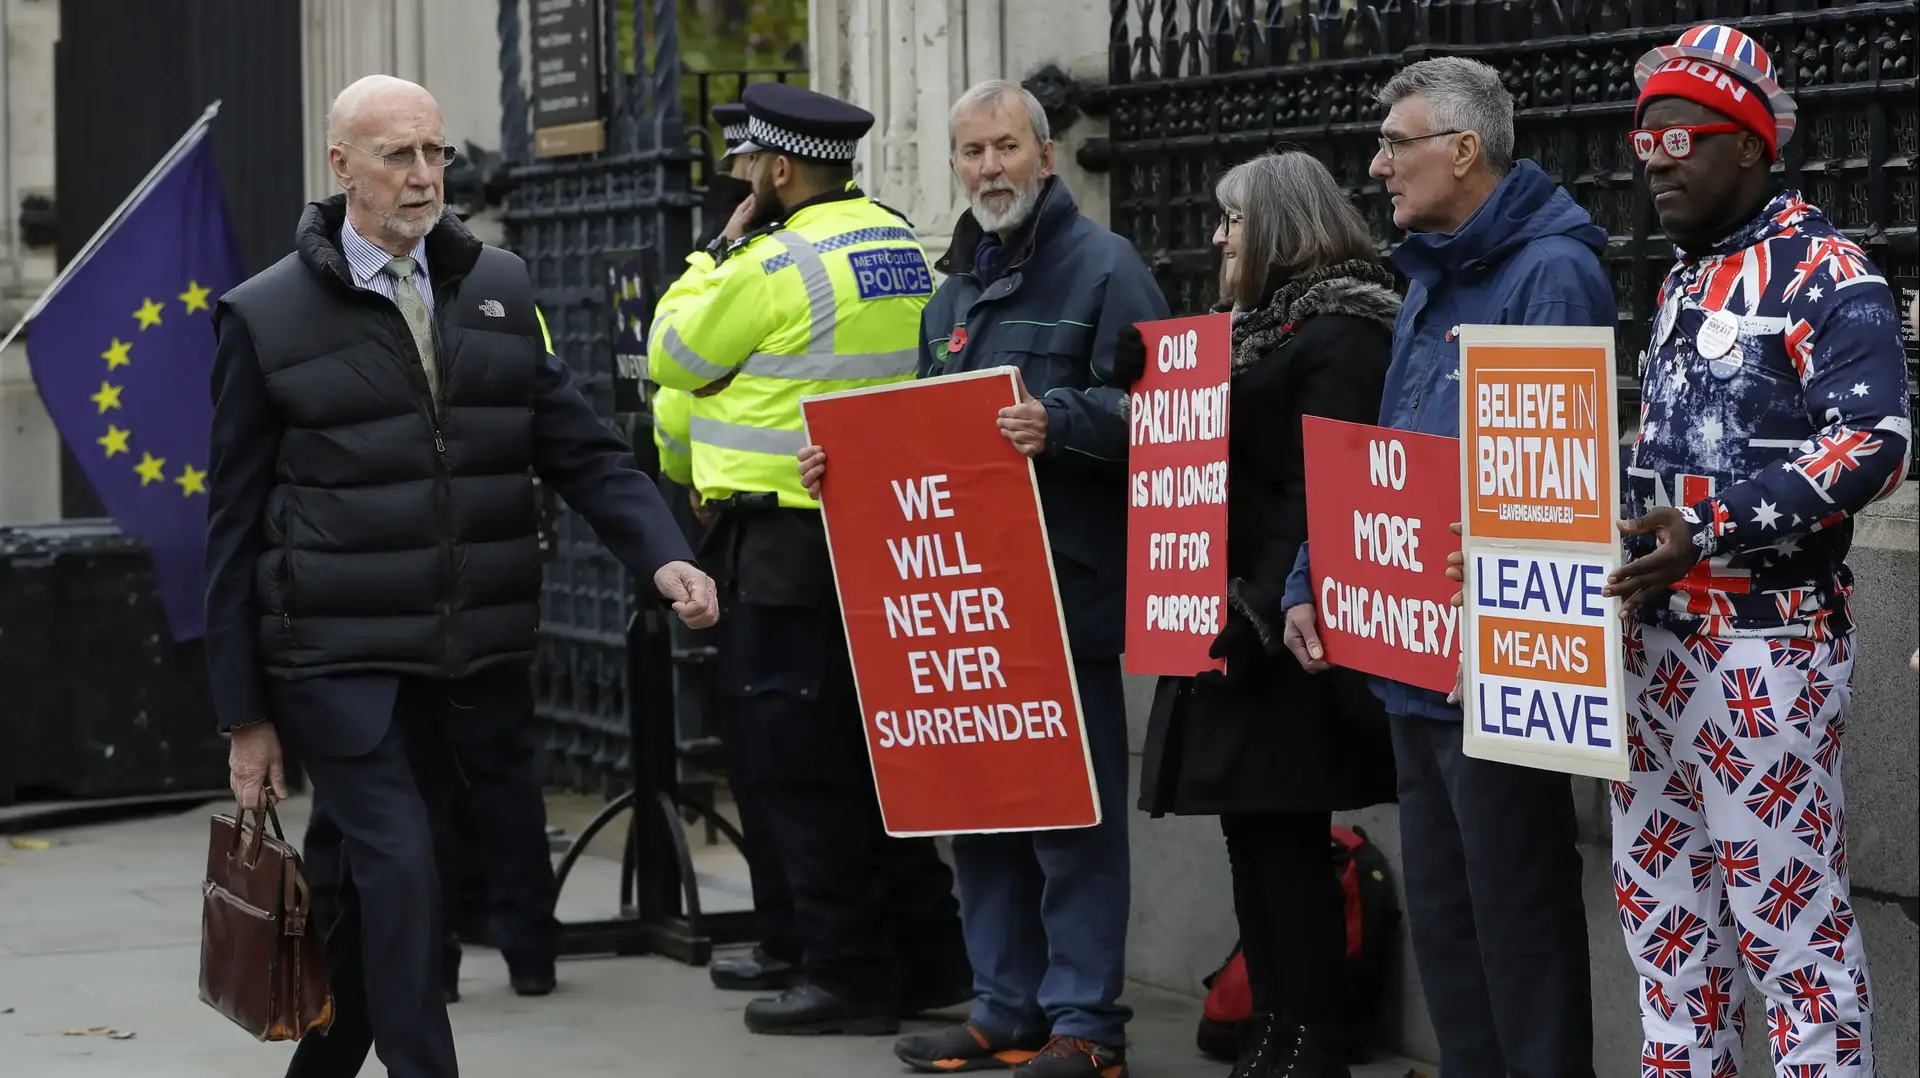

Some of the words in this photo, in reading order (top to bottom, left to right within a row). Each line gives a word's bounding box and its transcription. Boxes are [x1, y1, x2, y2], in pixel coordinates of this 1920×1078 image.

[1654, 59, 1747, 103] DON
[853, 252, 923, 267] METROOLITAN
[859, 266, 931, 293] POLICE
[1158, 329, 1198, 373] OUR
[1131, 382, 1229, 446] PARLIAMENT
[1478, 384, 1567, 430] BELIEVE
[1572, 384, 1594, 430] IN
[1132, 470, 1149, 508] IS
[1151, 466, 1174, 508] NO
[1176, 460, 1228, 508] LONGER
[1369, 439, 1407, 491] NO
[1478, 435, 1596, 500] BRITAIN
[890, 474, 955, 522] WE
[1499, 503, 1574, 524] LEAVEMEANSLEAVE.EU
[886, 531, 983, 580] WILL
[1150, 532, 1176, 571] FIT
[1178, 531, 1210, 571] FOR
[1353, 509, 1424, 573] MORE
[1477, 557, 1605, 617] LEAVE
[883, 586, 1011, 639] NEVER
[1146, 594, 1221, 636] PURPOSE
[1321, 576, 1463, 663] CHICANERY!
[907, 645, 1007, 694] EVER
[1493, 628, 1589, 674] MEANS
[875, 700, 1068, 748] SURRENDER
[1479, 683, 1612, 748] LEAVE
